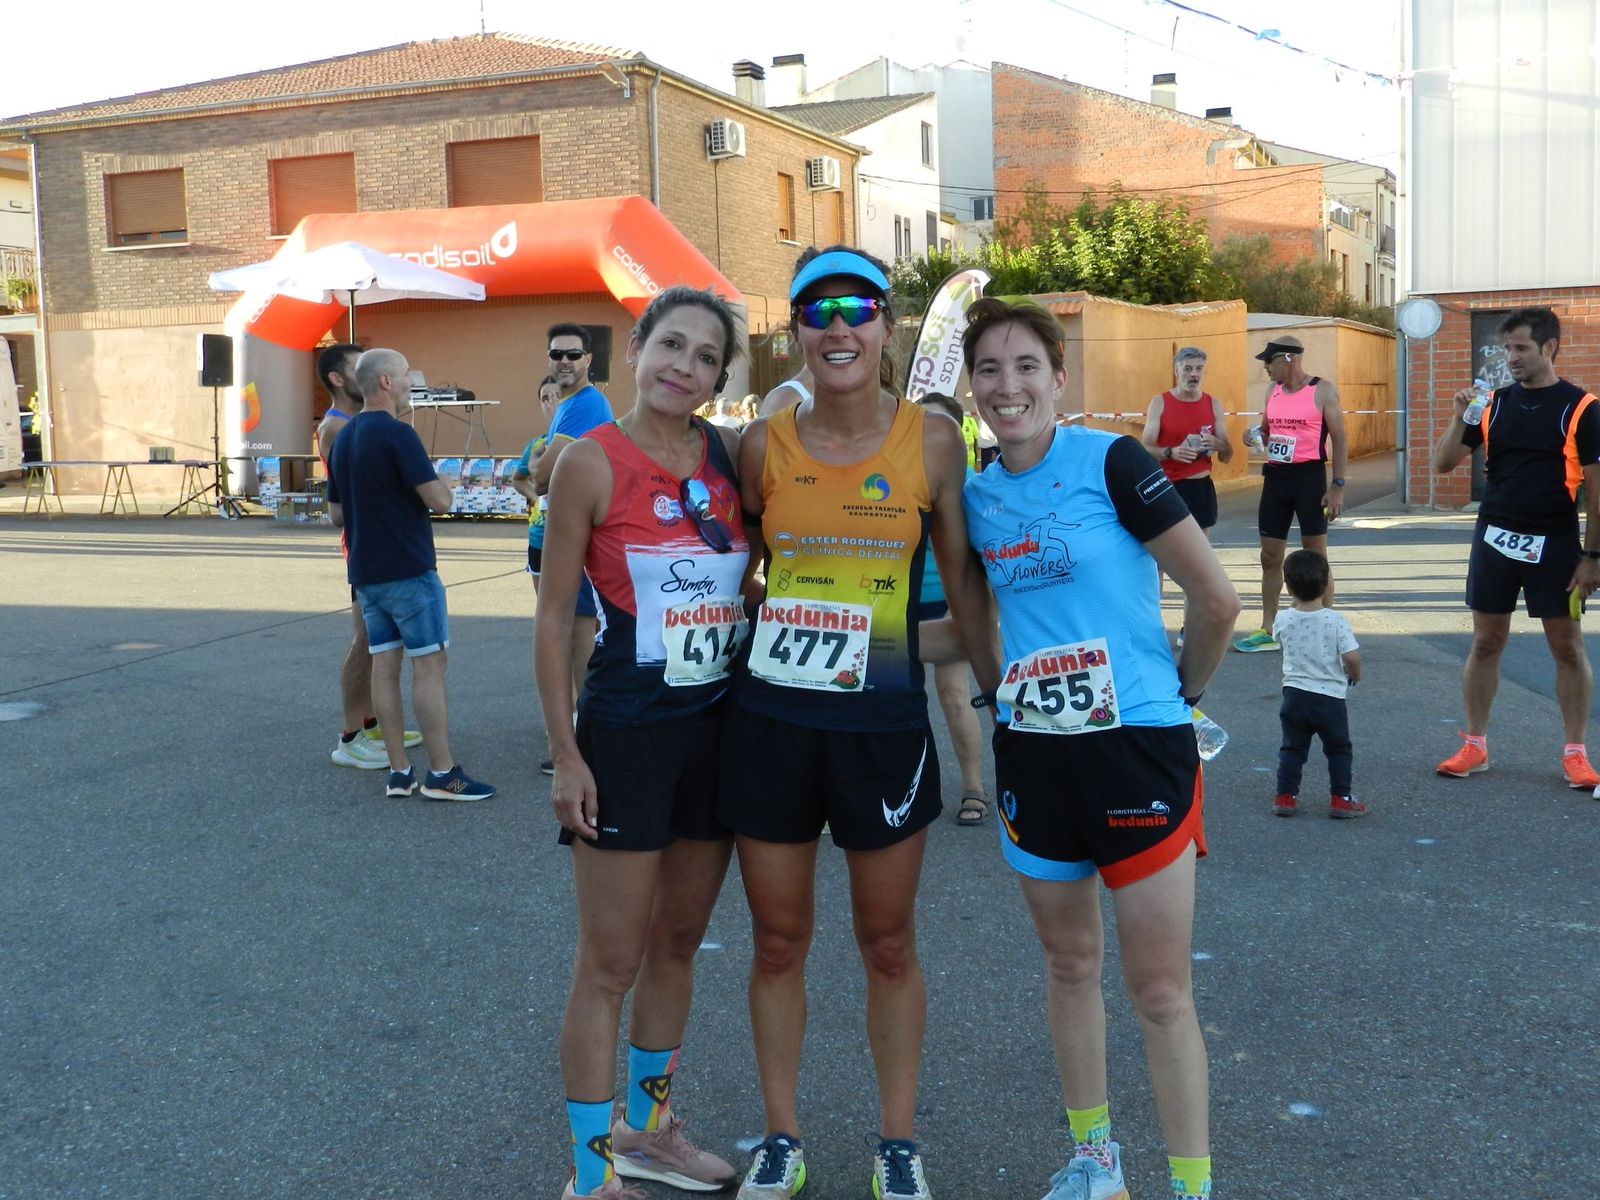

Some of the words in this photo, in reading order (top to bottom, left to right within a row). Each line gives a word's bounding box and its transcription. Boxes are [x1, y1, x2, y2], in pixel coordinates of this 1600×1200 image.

[1269, 443, 1288, 456] 450
[801, 537, 838, 545] ESTER
[1493, 531, 1534, 553] 482
[660, 559, 717, 594] Simón
[1012, 560, 1064, 582] FLOWERS
[760, 602, 868, 632] bedunia
[683, 625, 737, 665] 414
[768, 628, 849, 670] 477
[1015, 672, 1094, 716] 455
[1107, 815, 1168, 827] bedunia
